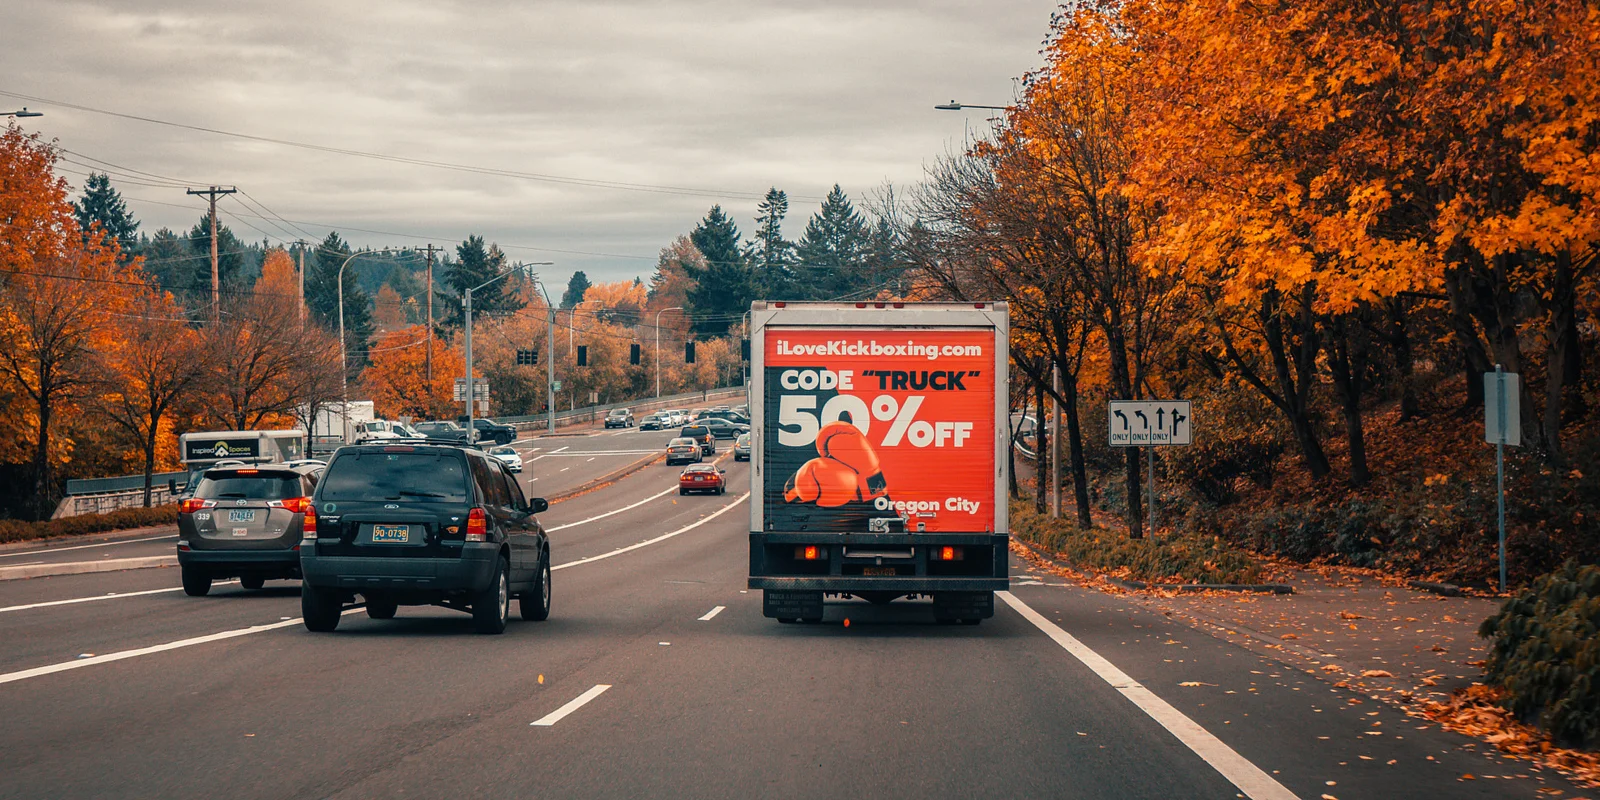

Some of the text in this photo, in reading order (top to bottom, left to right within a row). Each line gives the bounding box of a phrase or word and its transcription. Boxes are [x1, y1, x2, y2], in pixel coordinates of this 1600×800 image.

[777, 340, 982, 360] iLoveKickboxing.com
[780, 369, 854, 390] CODE
[778, 394, 974, 448] 50% OFF
[1112, 433, 1129, 441] ONLY
[1132, 433, 1149, 441] ONLY
[1152, 433, 1169, 441] ONLY
[874, 496, 981, 515] Oregon City
[197, 513, 210, 521] 339
